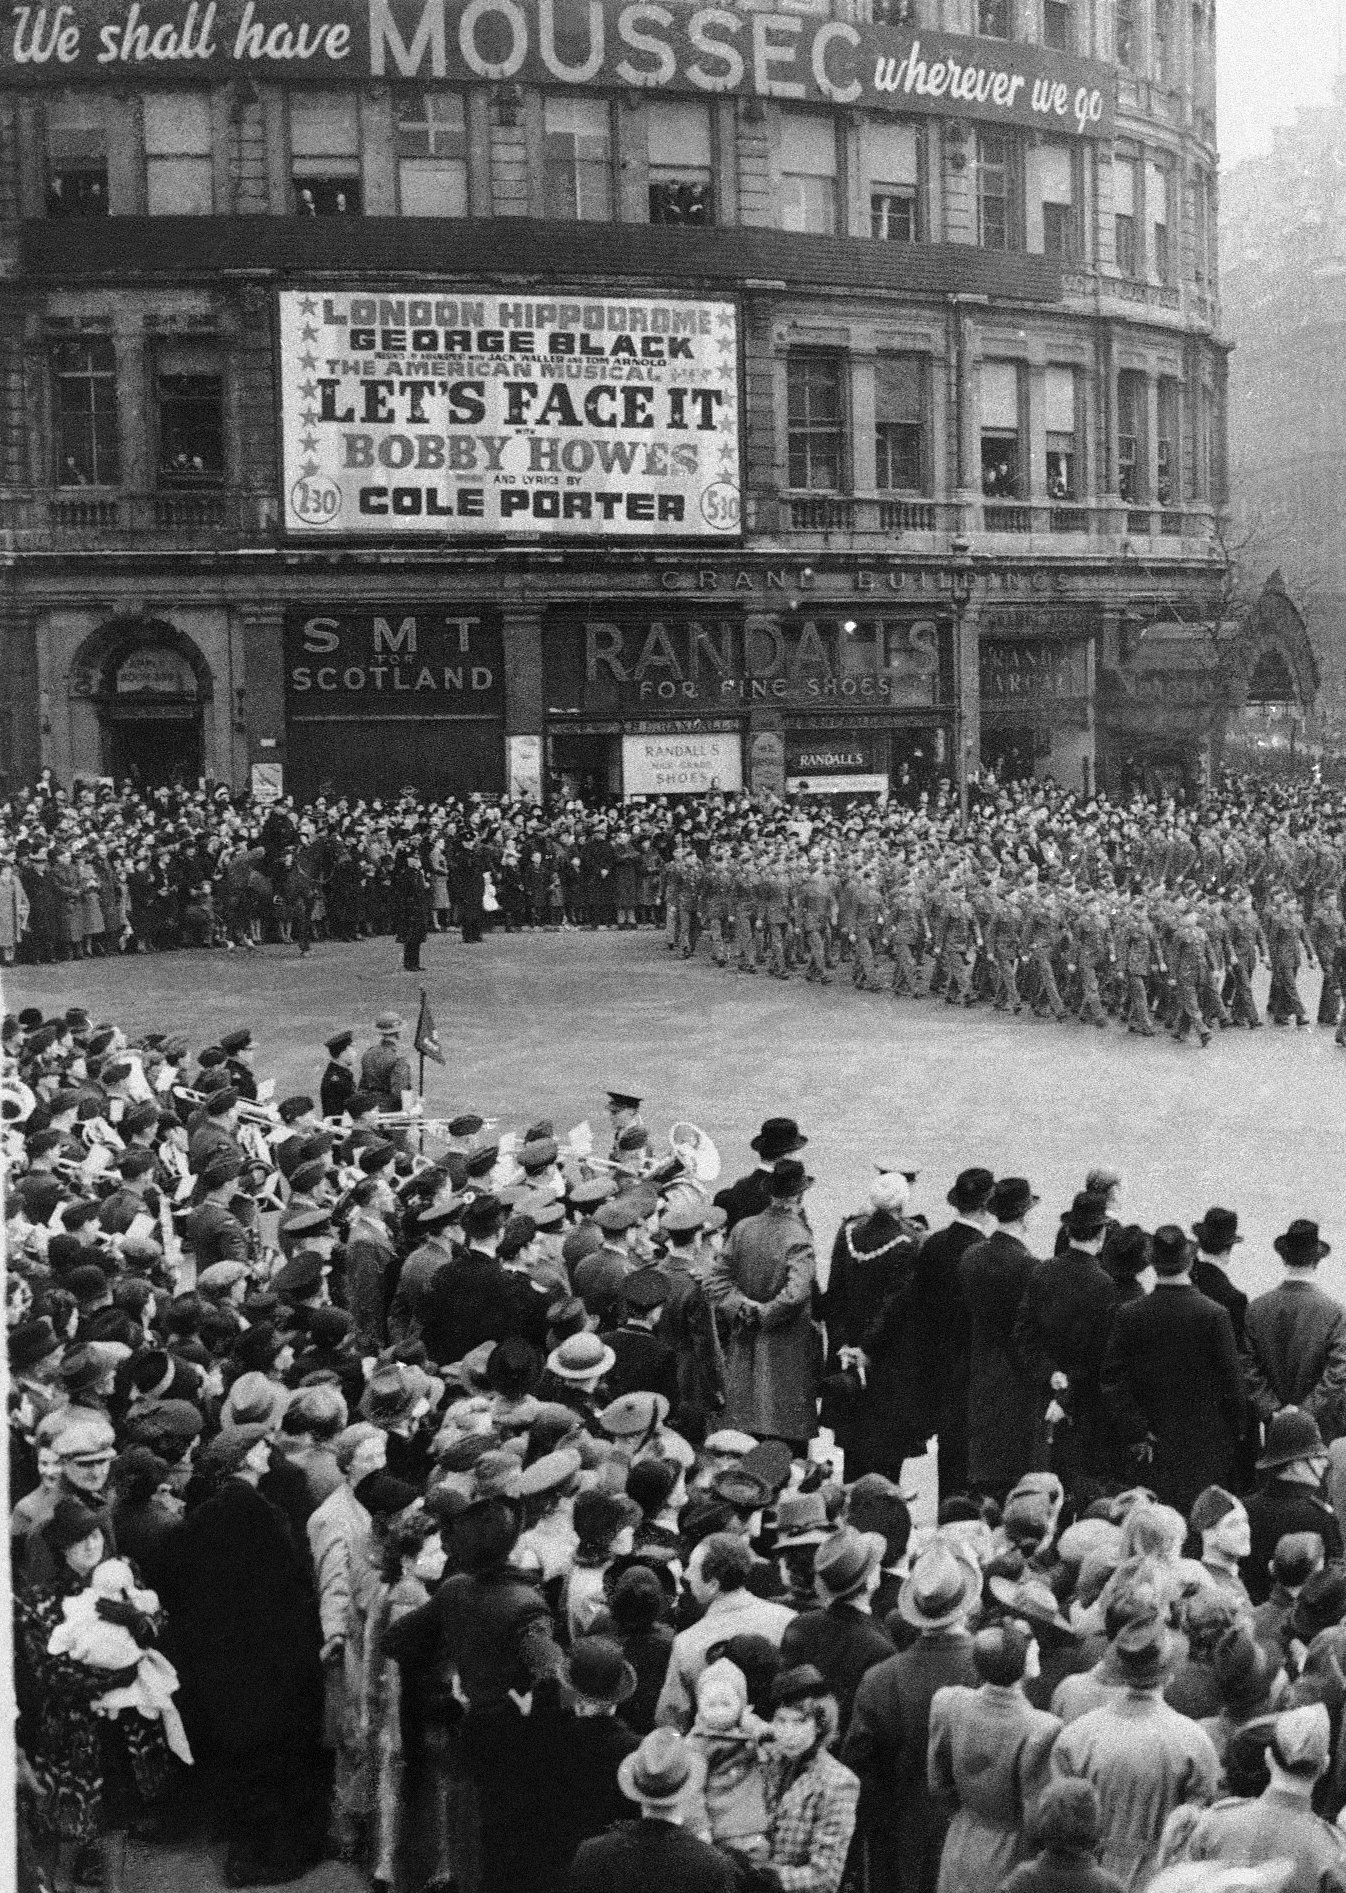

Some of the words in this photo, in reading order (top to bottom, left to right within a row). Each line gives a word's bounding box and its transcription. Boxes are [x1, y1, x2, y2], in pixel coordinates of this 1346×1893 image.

[13, 5, 80, 63] We
[97, 2, 217, 62] shall
[233, 6, 351, 60] have
[369, 0, 863, 103] MOUSSEC
[873, 39, 1026, 108] wherever
[1031, 77, 1072, 117] we
[1073, 87, 1104, 134] go
[322, 299, 484, 327] LONDON
[500, 302, 713, 334] HIPPODROME
[349, 329, 534, 353] GEORGE
[549, 333, 694, 359] BLACK
[326, 359, 376, 376] THE
[386, 360, 532, 378] AMERICAN
[541, 361, 662, 382] MUSICAL
[488, 354, 517, 362] JACK
[521, 355, 564, 364] WALLER
[586, 357, 609, 366] TOM
[613, 358, 667, 366] ARNOLD
[316, 378, 486, 424] LET'S
[503, 382, 654, 428] FACE
[666, 388, 722, 431] IT
[343, 433, 512, 470] BOBBY
[529, 436, 699, 475] HOWES
[493, 475, 516, 483] AND
[523, 475, 559, 484] LYRICS
[565, 476, 581, 485] BY
[359, 487, 485, 517] COLE
[500, 489, 686, 521] PORTER
[291, 666, 493, 691] SCOTLAND
[639, 681, 699, 699] FOR
[721, 679, 787, 698] FINE
[808, 677, 892, 697] SHOES
[656, 772, 708, 784] SHOES
